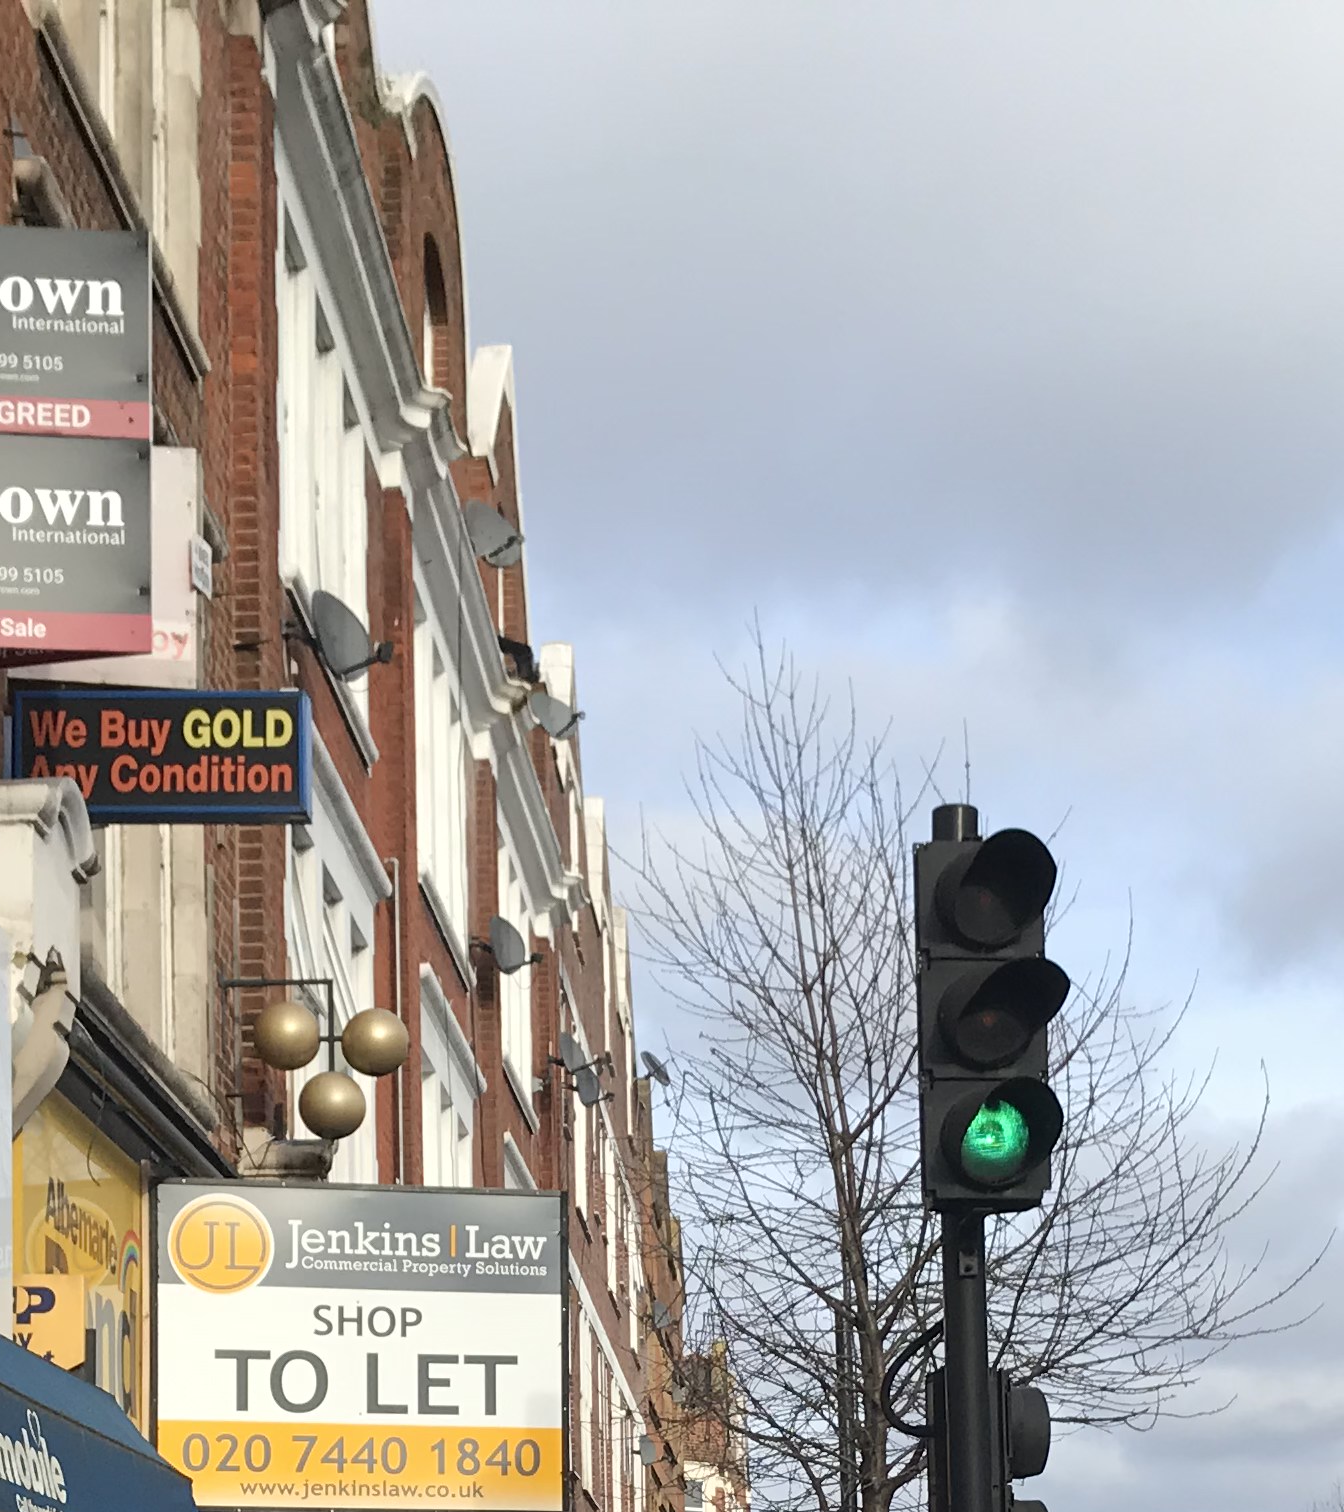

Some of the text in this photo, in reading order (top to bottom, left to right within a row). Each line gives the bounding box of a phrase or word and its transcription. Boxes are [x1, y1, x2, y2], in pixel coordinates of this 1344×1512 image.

[12, 314, 125, 334] International
[23, 355, 64, 372] 5105
[12, 526, 126, 546] International
[23, 568, 64, 585] 5105
[0, 617, 47, 638] Sale
[29, 708, 293, 755] We Buy GOLD
[109, 755, 293, 795] Condition
[45, 1176, 118, 1275] Albemarle
[285, 1218, 548, 1270] Jenkins Law
[301, 1256, 548, 1278] Commercial Property Solutions
[313, 1304, 423, 1338] SHOP
[214, 1348, 518, 1417] TO LET
[181, 1432, 541, 1478] 020 7440 1840
[240, 1479, 485, 1500] www.jenkinslaw.co.uk
